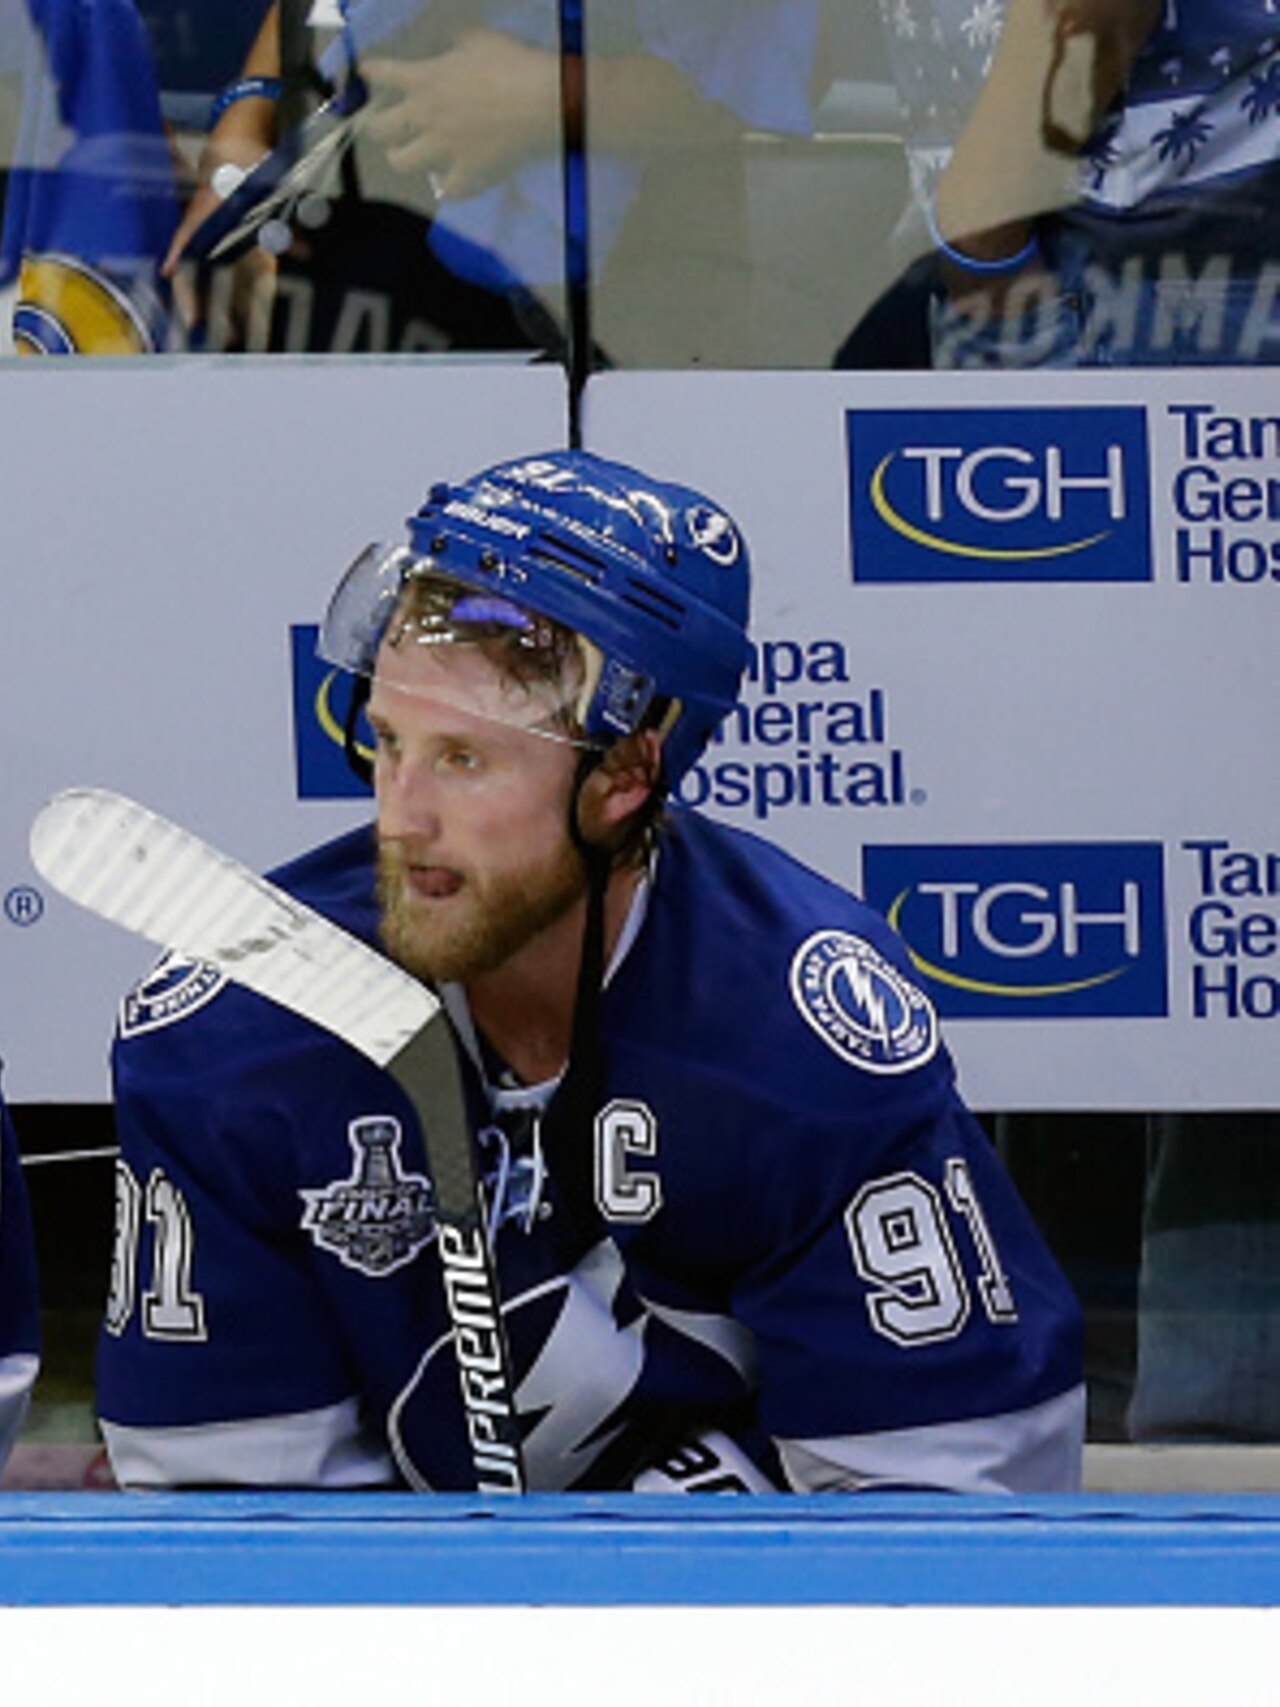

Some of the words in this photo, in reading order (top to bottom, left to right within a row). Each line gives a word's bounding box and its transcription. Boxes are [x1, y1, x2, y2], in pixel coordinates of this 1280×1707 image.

[902, 445, 1126, 521] TGH
[918, 880, 1140, 958] TGH
[594, 1097, 663, 1224] C
[843, 1157, 1019, 1348] 91
